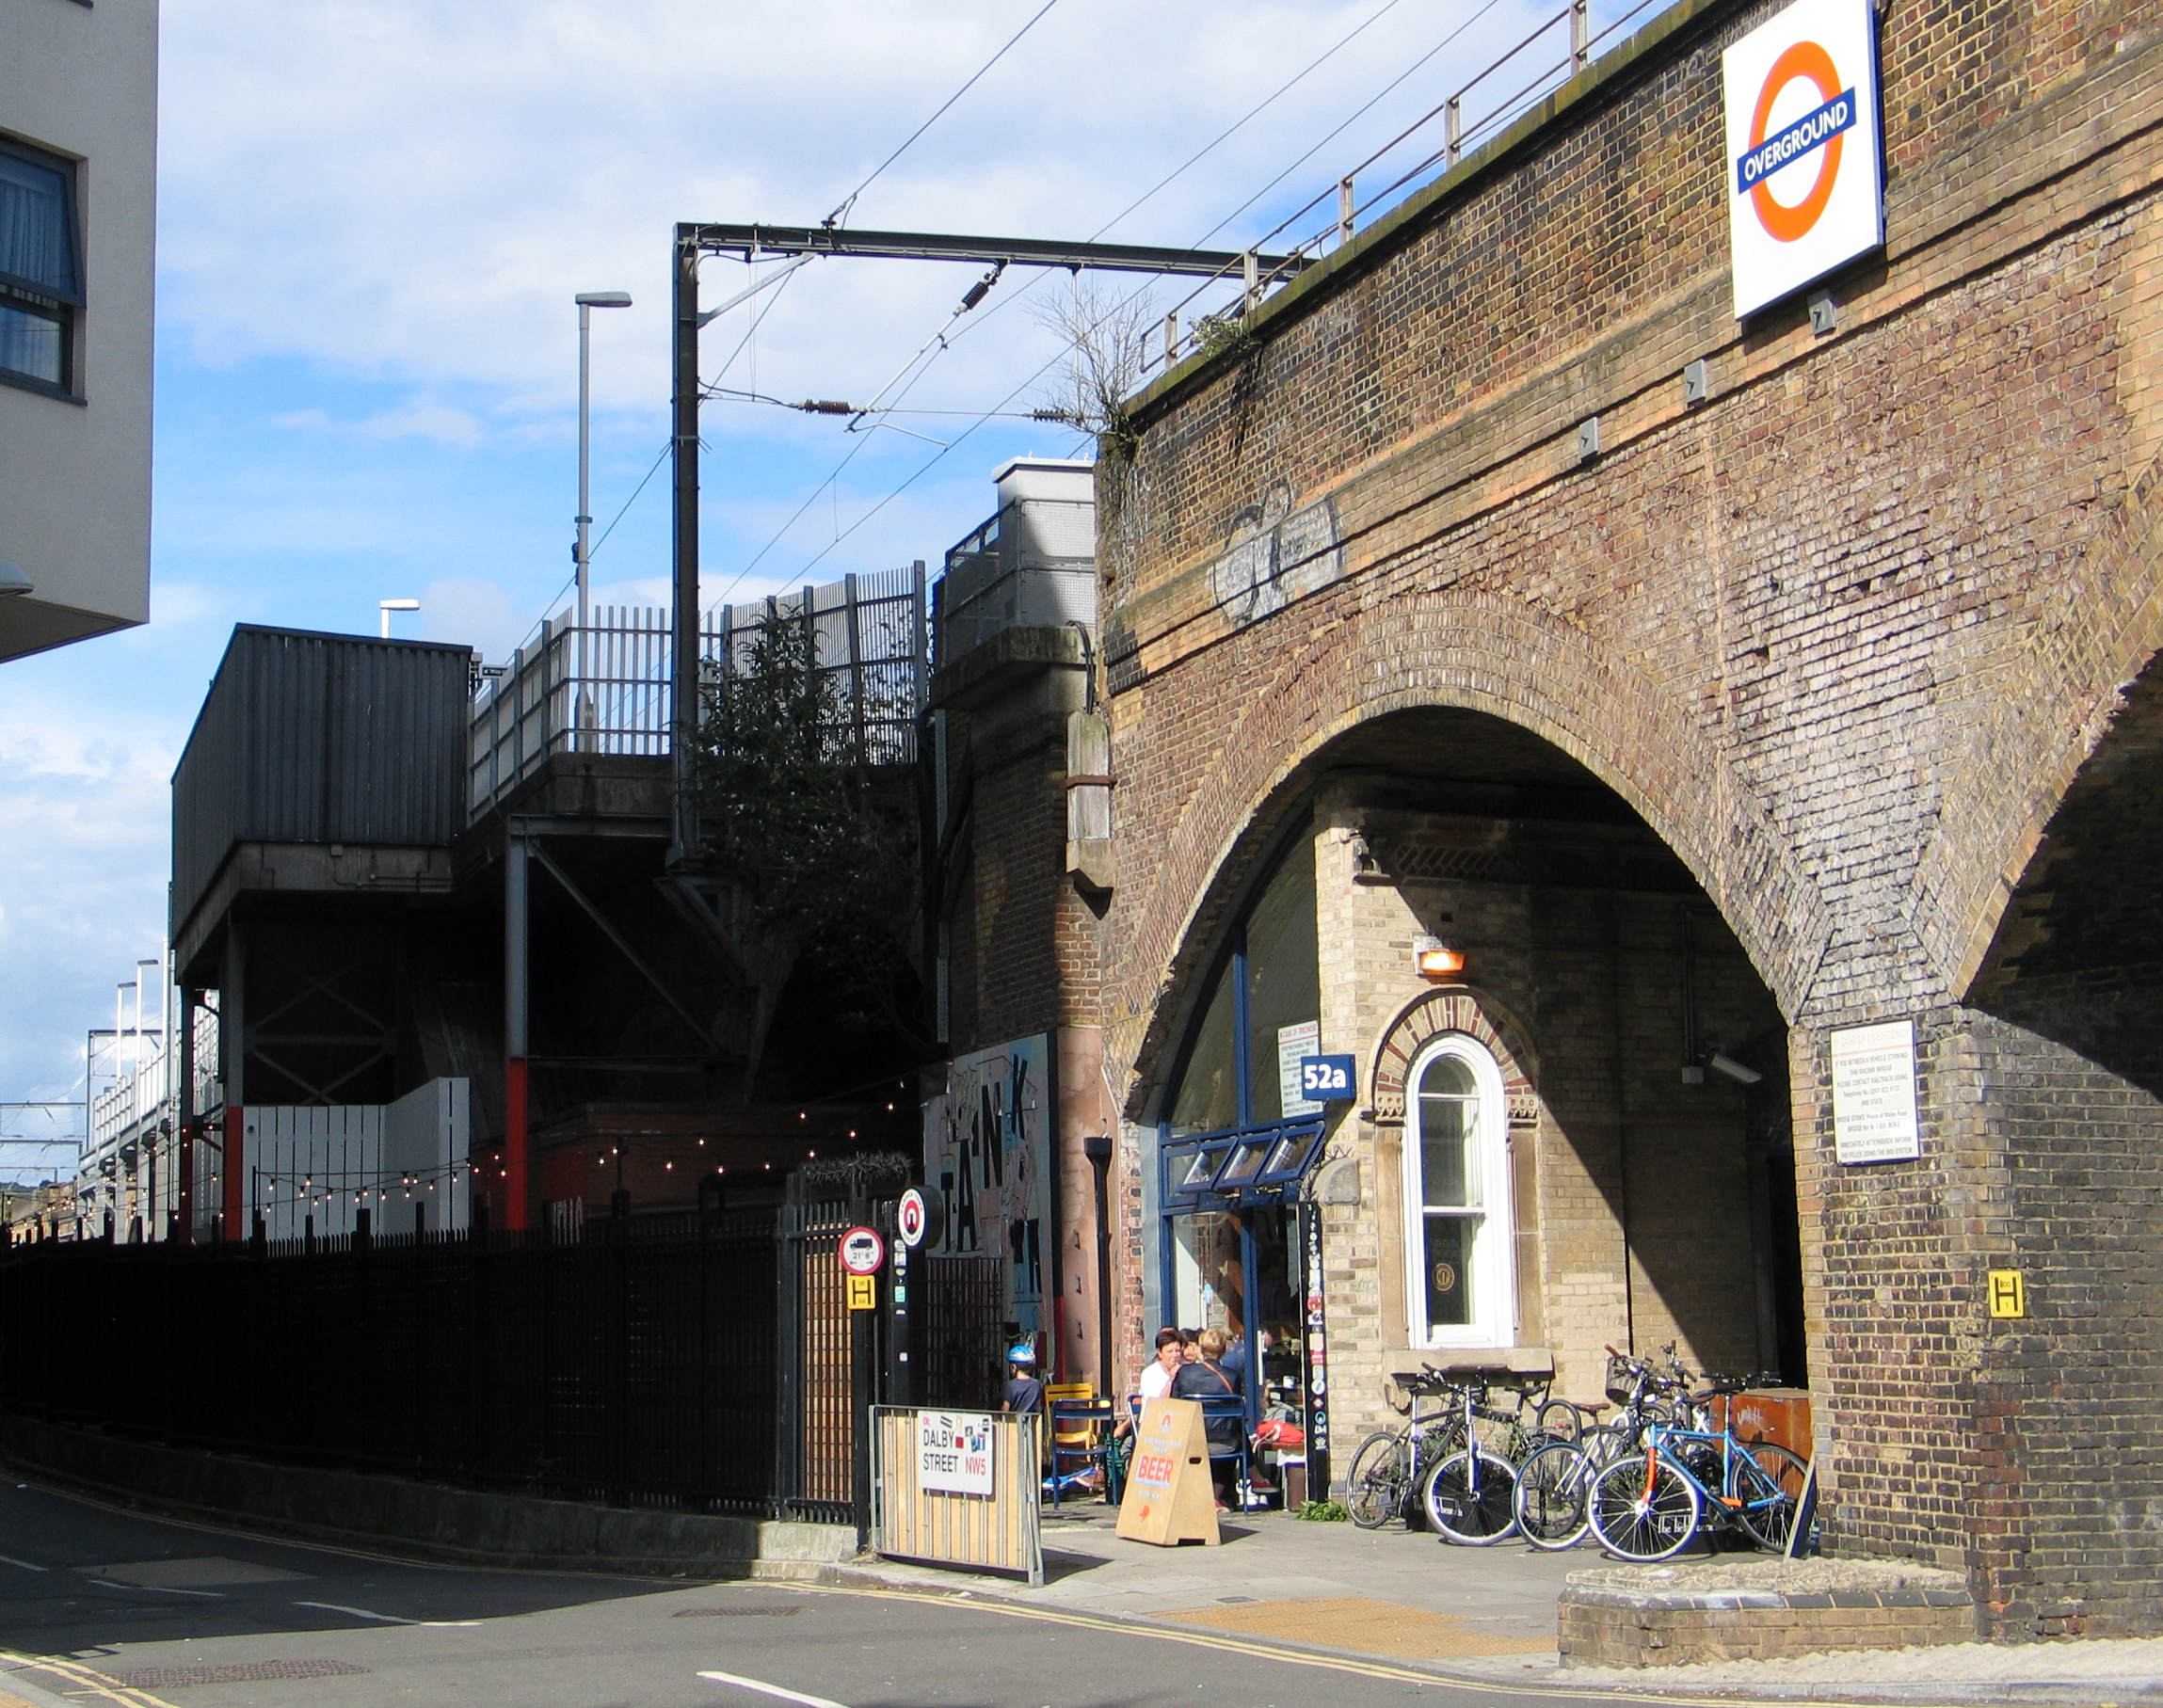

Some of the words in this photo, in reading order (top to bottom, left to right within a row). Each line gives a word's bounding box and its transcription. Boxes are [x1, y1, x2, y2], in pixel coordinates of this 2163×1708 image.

[1744, 101, 1849, 182] OVERGROUND
[1305, 1064, 1346, 1090] 52a
[853, 1280, 871, 1305] H
[1995, 1277, 2018, 1312] H
[923, 1429, 954, 1448] DALBY
[923, 1453, 958, 1473] STREET
[966, 1456, 986, 1477] NW5
[1138, 1455, 1174, 1483] BEER
